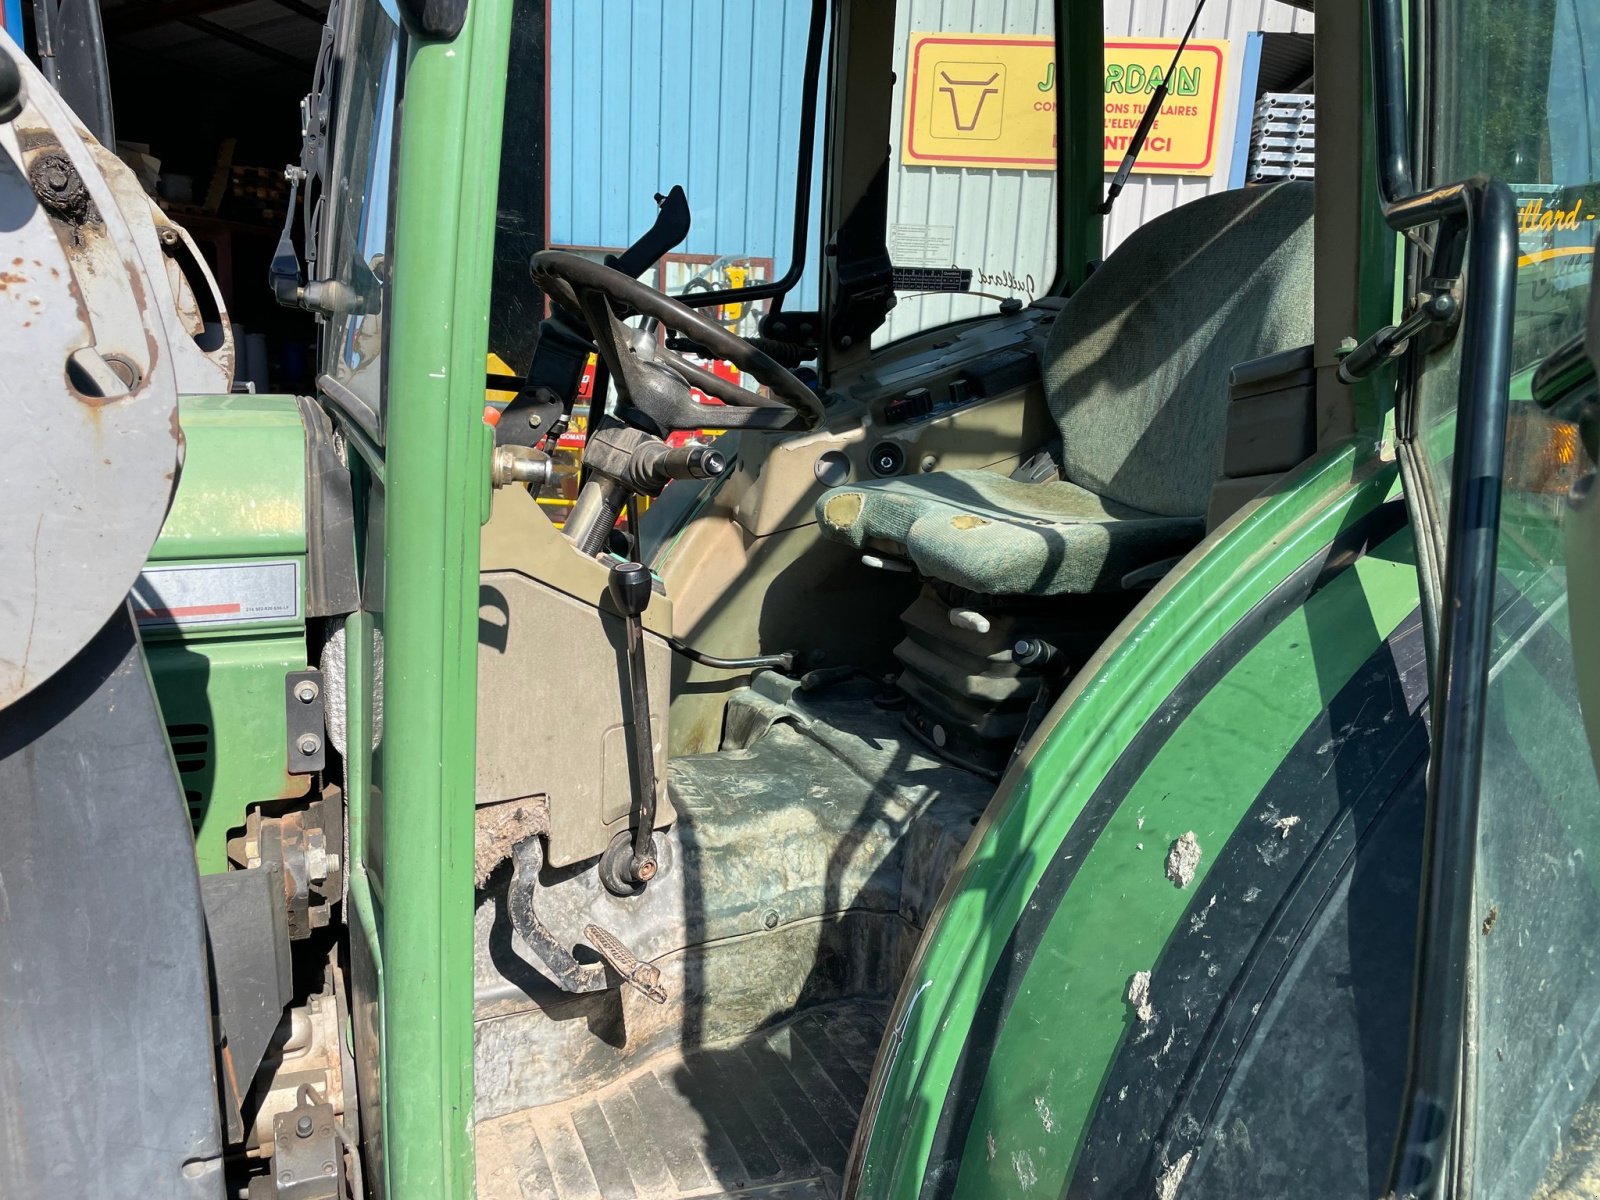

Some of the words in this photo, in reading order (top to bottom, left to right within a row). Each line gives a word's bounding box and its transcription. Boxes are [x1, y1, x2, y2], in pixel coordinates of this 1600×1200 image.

[1037, 62, 1201, 97] JRDAIN
[1133, 103, 1198, 116] TULAIRES
[1104, 118, 1159, 130] L'ELEVE
[1518, 197, 1583, 233] illard
